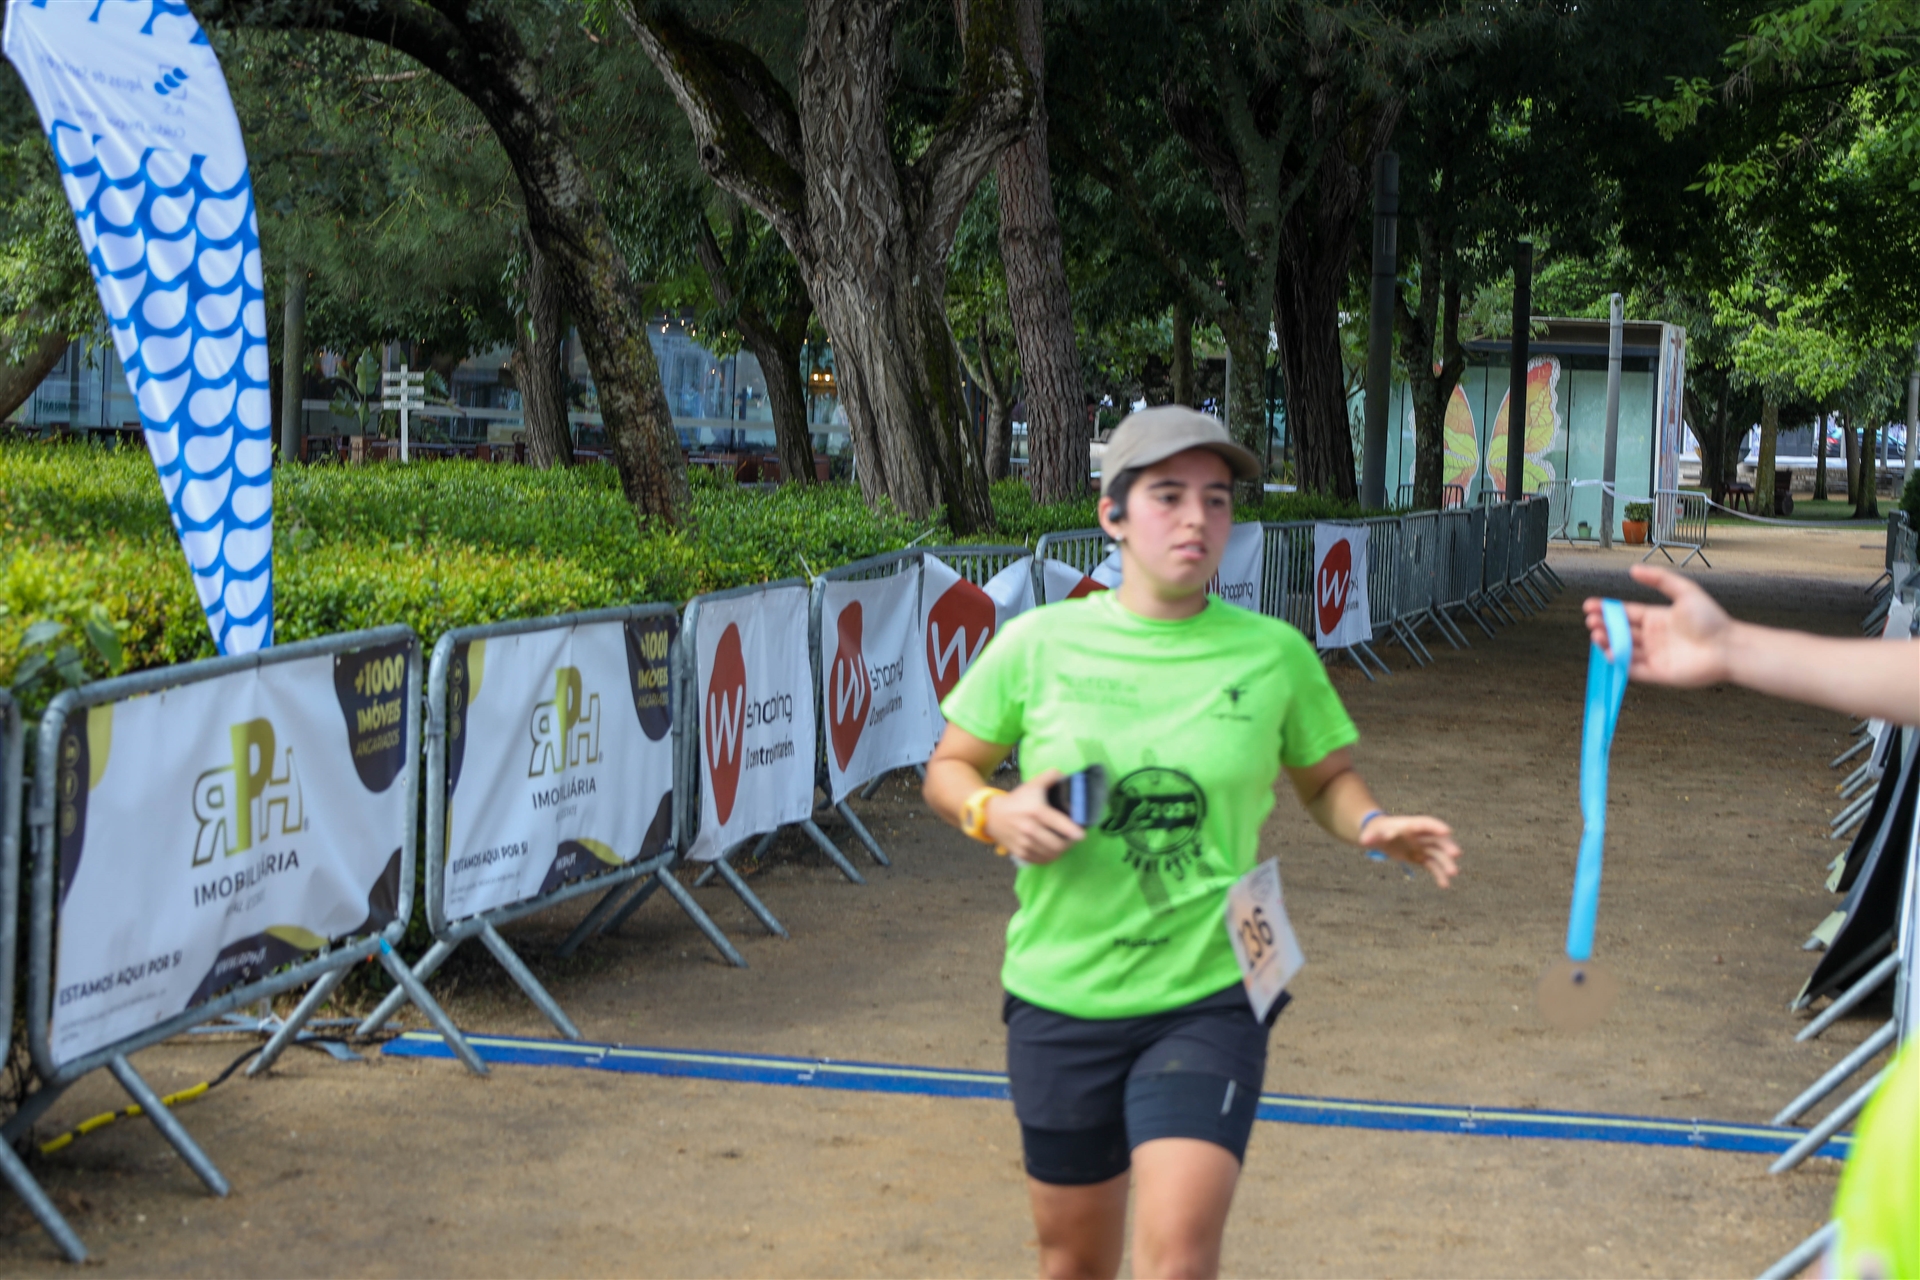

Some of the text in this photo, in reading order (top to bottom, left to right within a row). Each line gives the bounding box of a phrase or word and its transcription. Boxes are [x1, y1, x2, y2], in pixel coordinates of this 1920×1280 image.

[1322, 567, 1350, 609] W
[354, 653, 405, 698] +1000
[931, 621, 990, 682] W
[836, 653, 866, 726] W
[710, 684, 744, 771] W
[147, 954, 171, 977] POR
